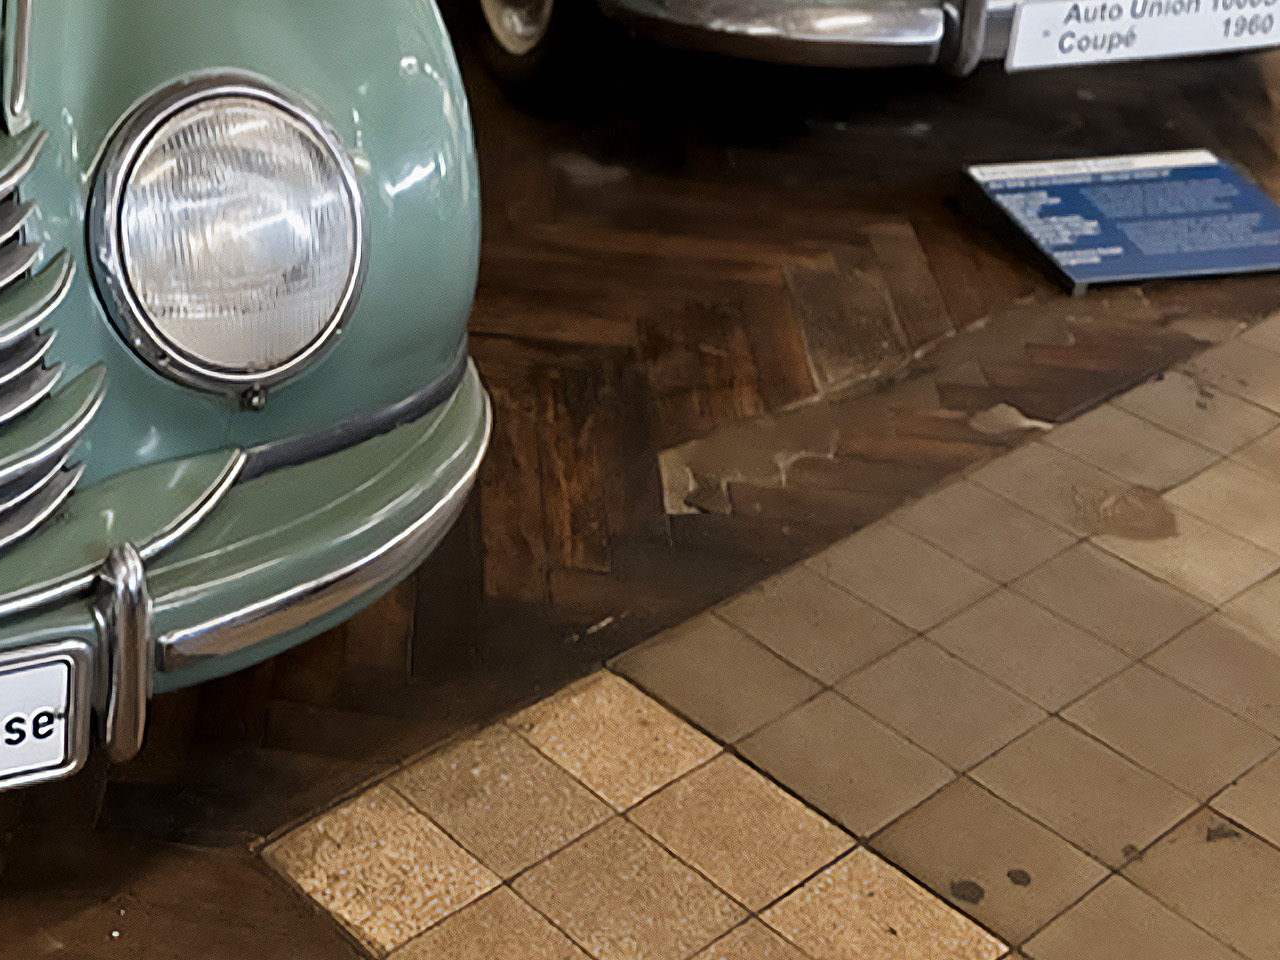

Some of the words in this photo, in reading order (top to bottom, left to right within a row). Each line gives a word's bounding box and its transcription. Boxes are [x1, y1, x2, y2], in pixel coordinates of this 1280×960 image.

[1063, 3, 1124, 25] Auto
[1057, 24, 1137, 54] Coupé
[1223, 13, 1275, 38] 1960
